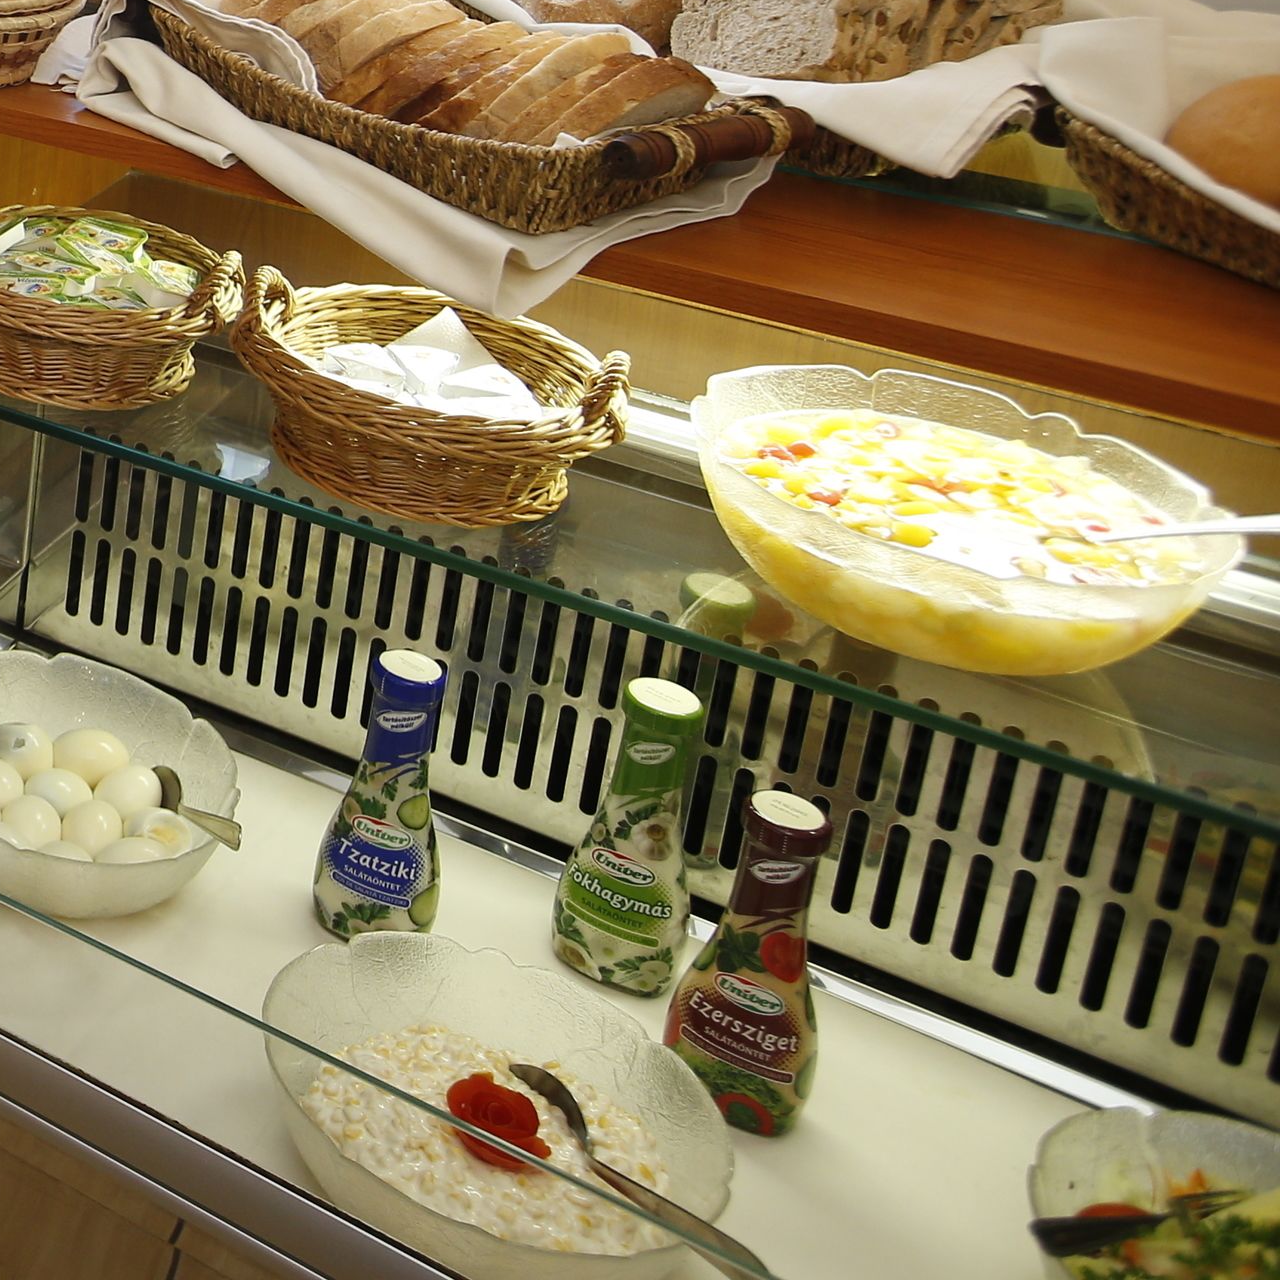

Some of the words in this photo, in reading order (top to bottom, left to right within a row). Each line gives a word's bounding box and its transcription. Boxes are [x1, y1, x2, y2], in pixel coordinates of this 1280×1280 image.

[356, 820, 408, 845] Univer
[338, 837, 416, 880] Tzatziki
[595, 852, 652, 881] Univer
[568, 863, 672, 918] Fokhagymás
[718, 977, 779, 1010] Univer
[688, 990, 799, 1052] Ezersziget
